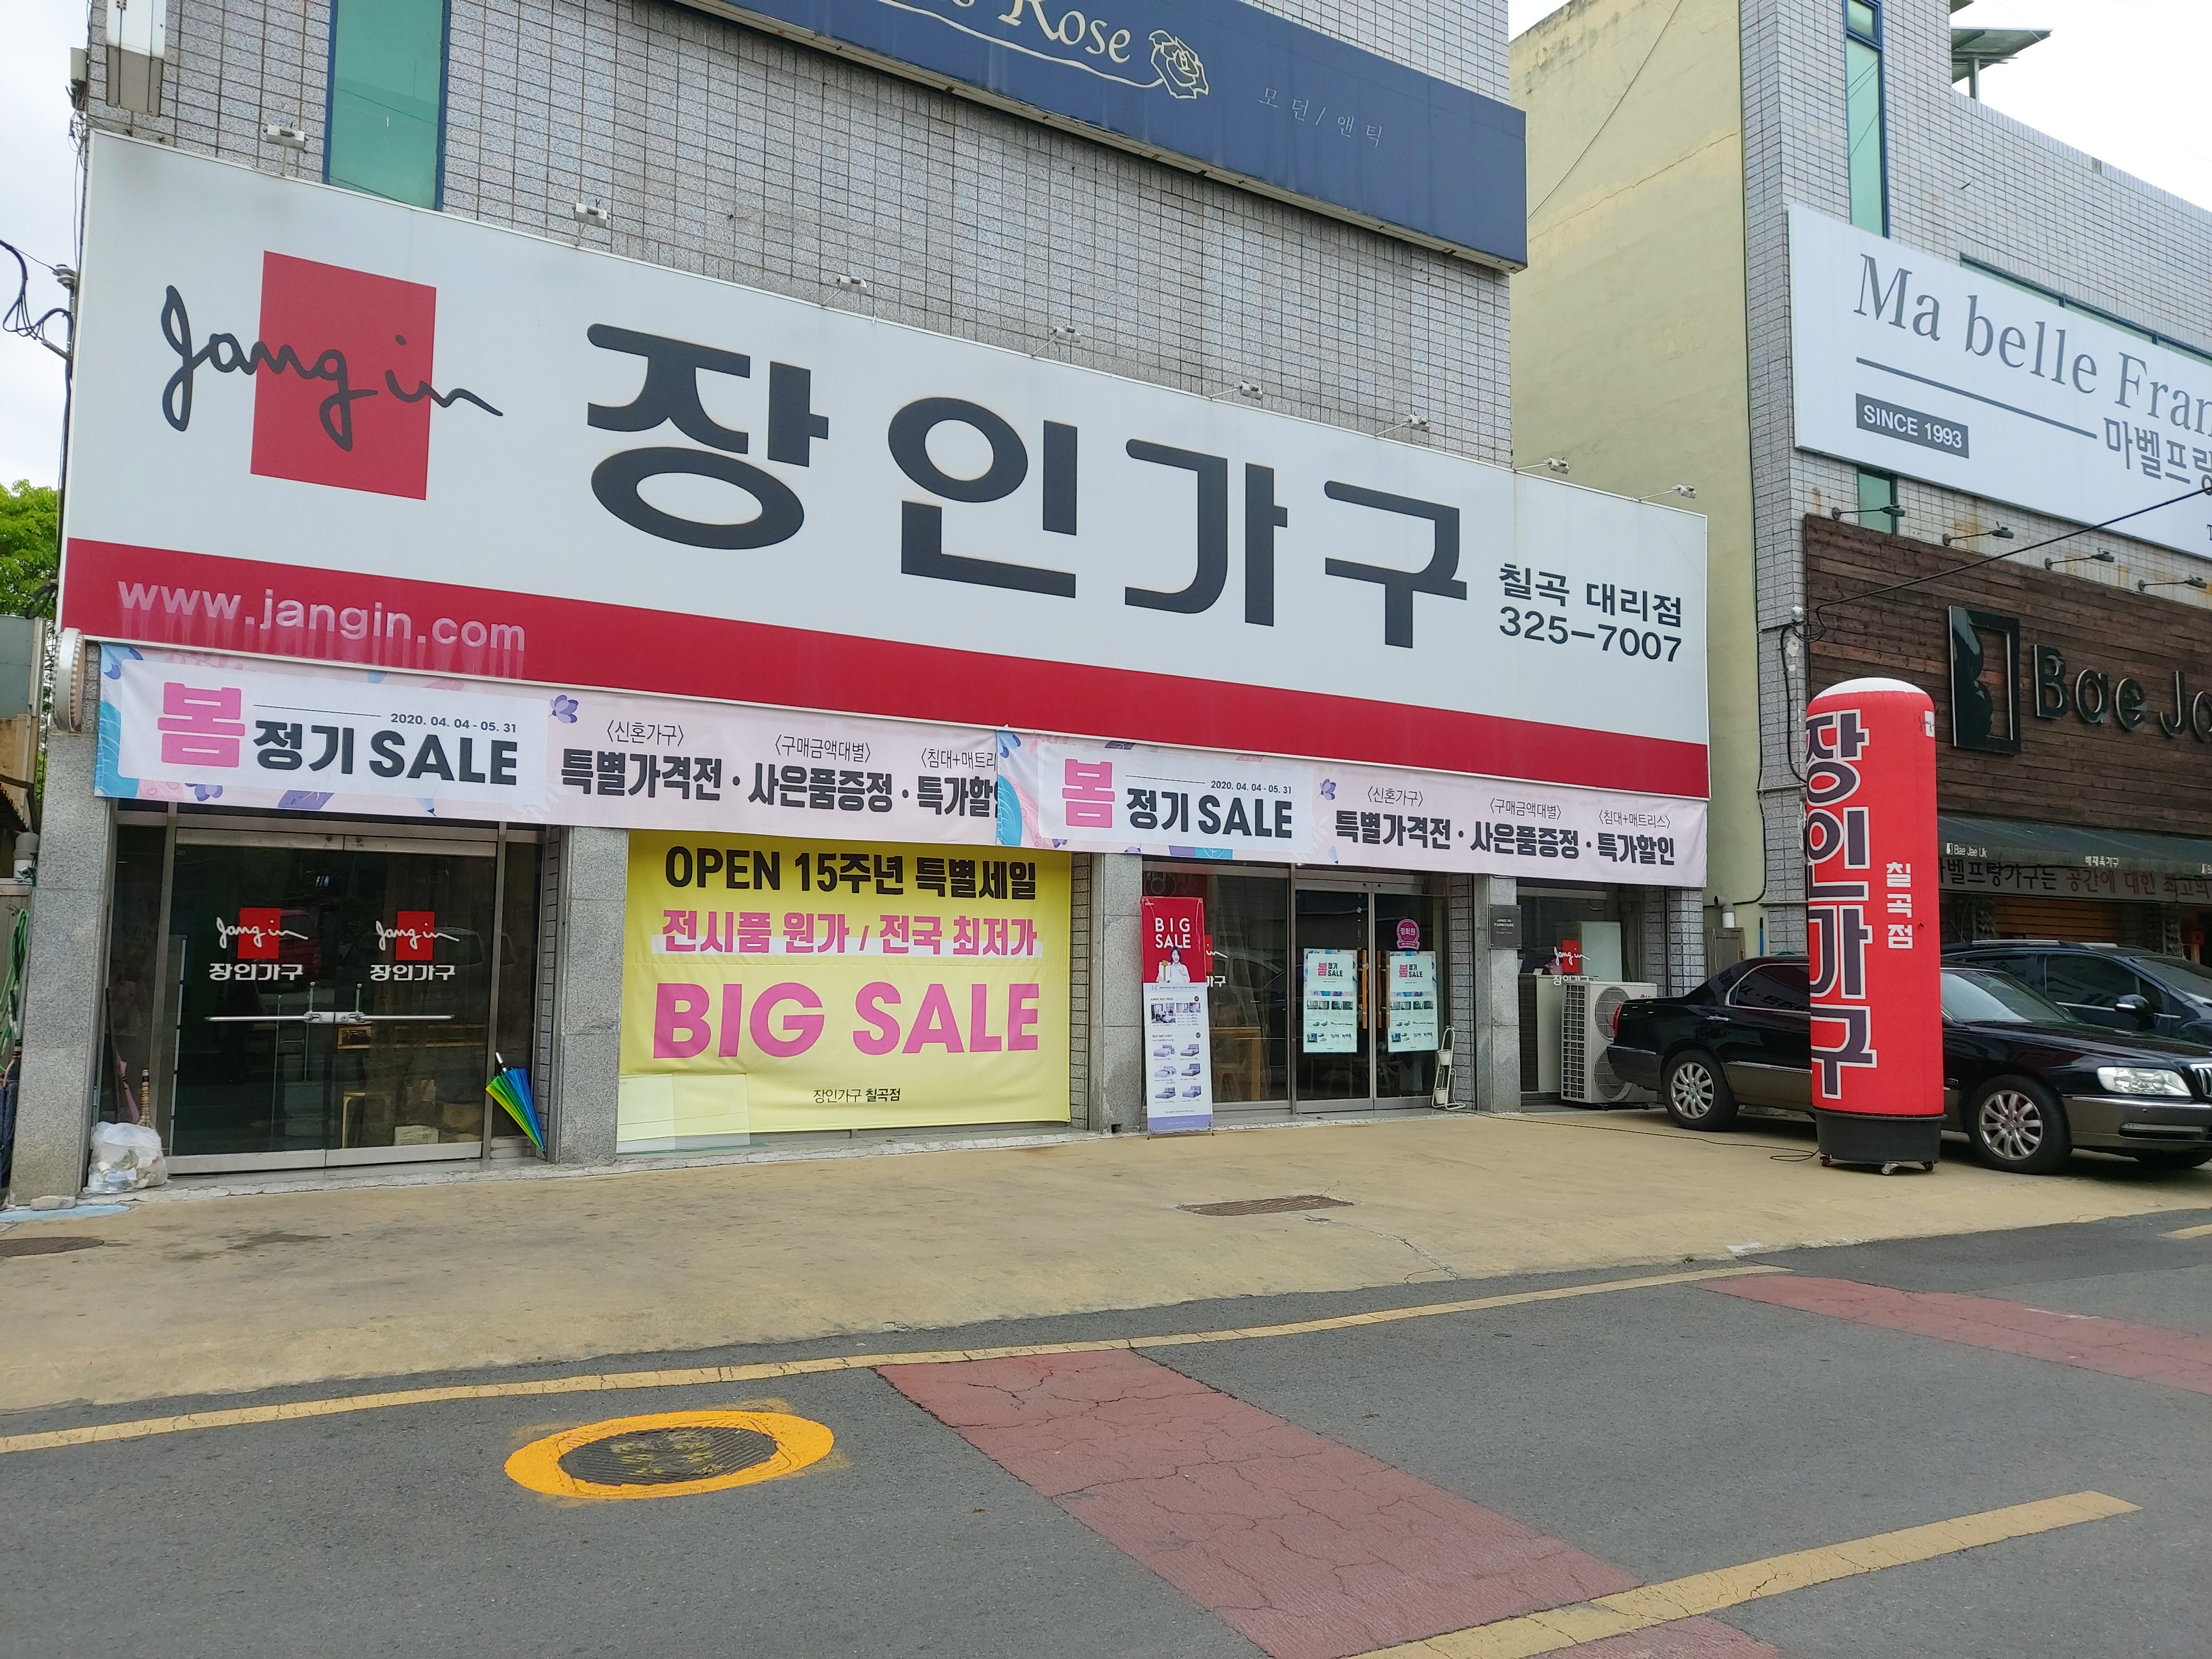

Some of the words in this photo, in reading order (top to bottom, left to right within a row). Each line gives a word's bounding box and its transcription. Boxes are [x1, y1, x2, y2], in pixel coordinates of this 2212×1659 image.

[1854, 253, 1940, 341] Ma
[1965, 295, 2097, 394] belle
[1863, 404, 1918, 436] SINCE
[1925, 422, 1962, 448] 1993
[587, 323, 1467, 648] 장인가구
[117, 580, 526, 652] www.jangin.com
[1499, 563, 1570, 607] 칠곡
[1587, 583, 1681, 628] 대리점
[1499, 606, 1681, 662] 325-7007
[2034, 644, 2146, 731] Bae
[157, 682, 245, 768] 봄
[253, 720, 354, 775] 정기
[369, 730, 518, 786] SALE
[390, 713, 426, 725] 2020.
[430, 716, 450, 727] 04.
[454, 719, 470, 729] 04
[481, 721, 499, 731] 05.
[503, 723, 516, 733] 31
[561, 748, 721, 801] 특별가격전
[748, 762, 893, 812] 사은품증정
[917, 775, 998, 819] 특가할
[1062, 758, 1115, 828] 봄
[1126, 788, 1189, 832] 정기
[1198, 794, 1292, 839] SALE
[1210, 780, 1234, 789] 2020.
[1236, 782, 1249, 791] 04.
[1268, 785, 1280, 793] 05.
[1335, 810, 1451, 850] 특별가격전
[1470, 821, 1579, 859] 사은품증정
[1598, 832, 1675, 866] 특가할인
[1954, 844, 1966, 855] Bae
[1967, 846, 1977, 857] Jae
[1979, 847, 1987, 857] Uk
[665, 845, 782, 891] OPEN
[795, 852, 904, 895] 15주년
[915, 856, 1036, 900] 특별세일
[2066, 867, 2116, 894] 공간에
[2123, 871, 2156, 895] 대한
[1807, 708, 1878, 1100] 장인가구
[1886, 861, 1915, 950] 칠곡점
[662, 910, 772, 953] 전시품
[783, 913, 850, 955] 원가
[879, 915, 943, 955] 전국
[952, 916, 1038, 956] 최저가
[1155, 933, 1191, 949] SALE
[209, 963, 304, 981] 장인가구
[370, 964, 456, 981] 장인가구
[1206, 975, 1226, 988] 가구
[1318, 962, 1327, 976] 봄
[653, 981, 826, 1058] BIG
[853, 981, 1040, 1055] SALE
[813, 1088, 862, 1104] 장인가구
[865, 1088, 901, 1102] 칠곡점
